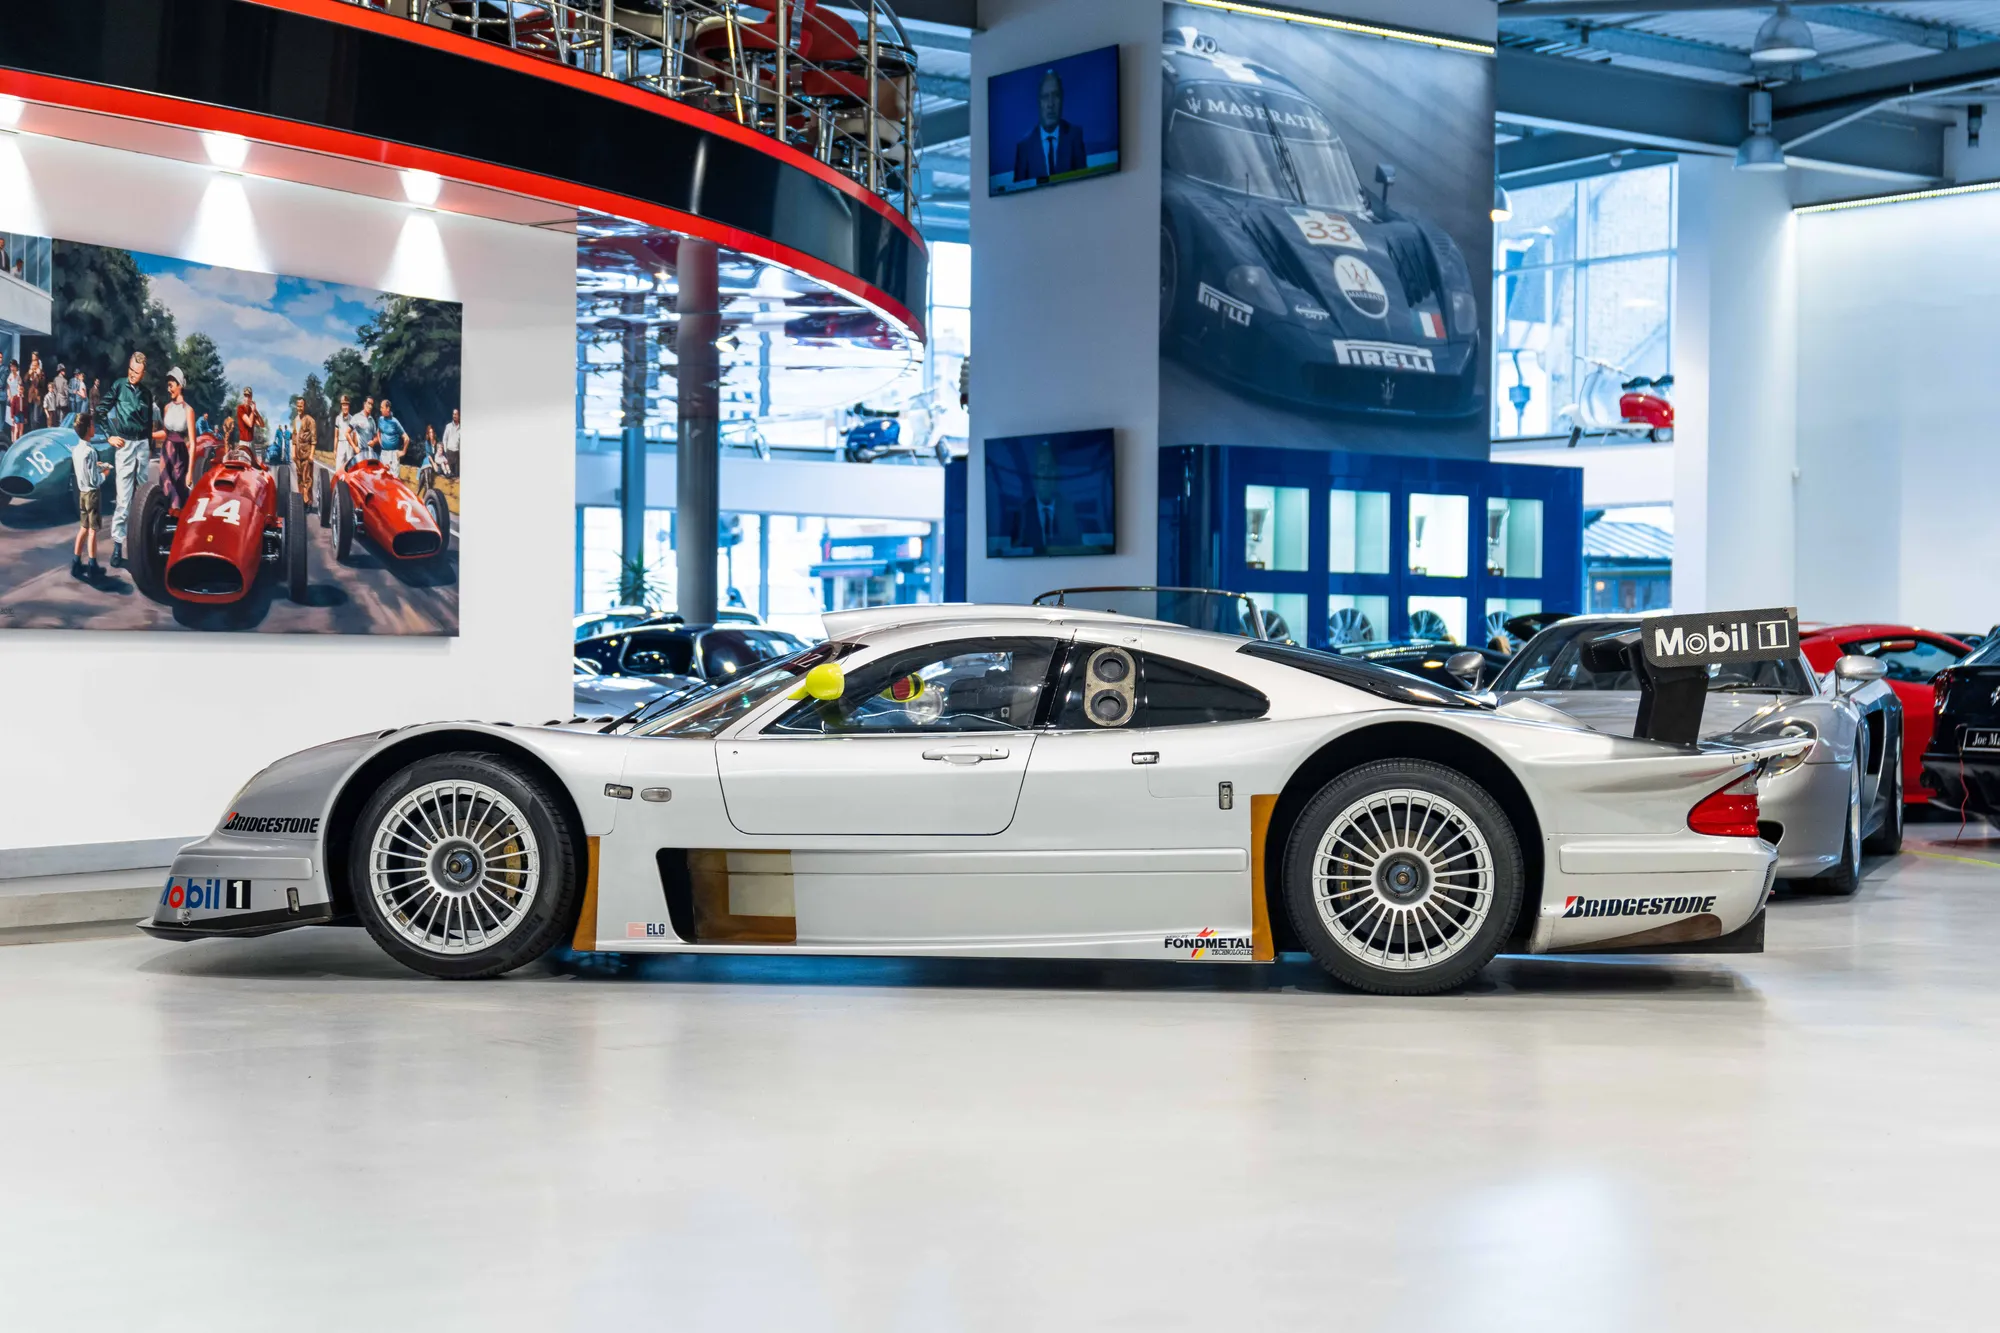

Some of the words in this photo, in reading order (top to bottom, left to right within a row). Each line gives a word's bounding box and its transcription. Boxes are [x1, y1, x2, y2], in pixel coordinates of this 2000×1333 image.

[1206, 98, 1319, 131] MASERATI
[1305, 220, 1351, 242] 33
[1198, 281, 1254, 327] PIRLLI
[1333, 339, 1436, 373] PIRELLI
[26, 451, 55, 475] 18
[187, 497, 241, 526] 14
[397, 500, 421, 522] 2
[1655, 622, 1749, 657] Mobil
[1972, 732, 1987, 746] Joe
[223, 812, 320, 833] BRIDGESTONE
[1561, 896, 1717, 918] BRIDGESTONE
[646, 923, 665, 935] ELG
[1164, 938, 1254, 949] FONDMETAL
